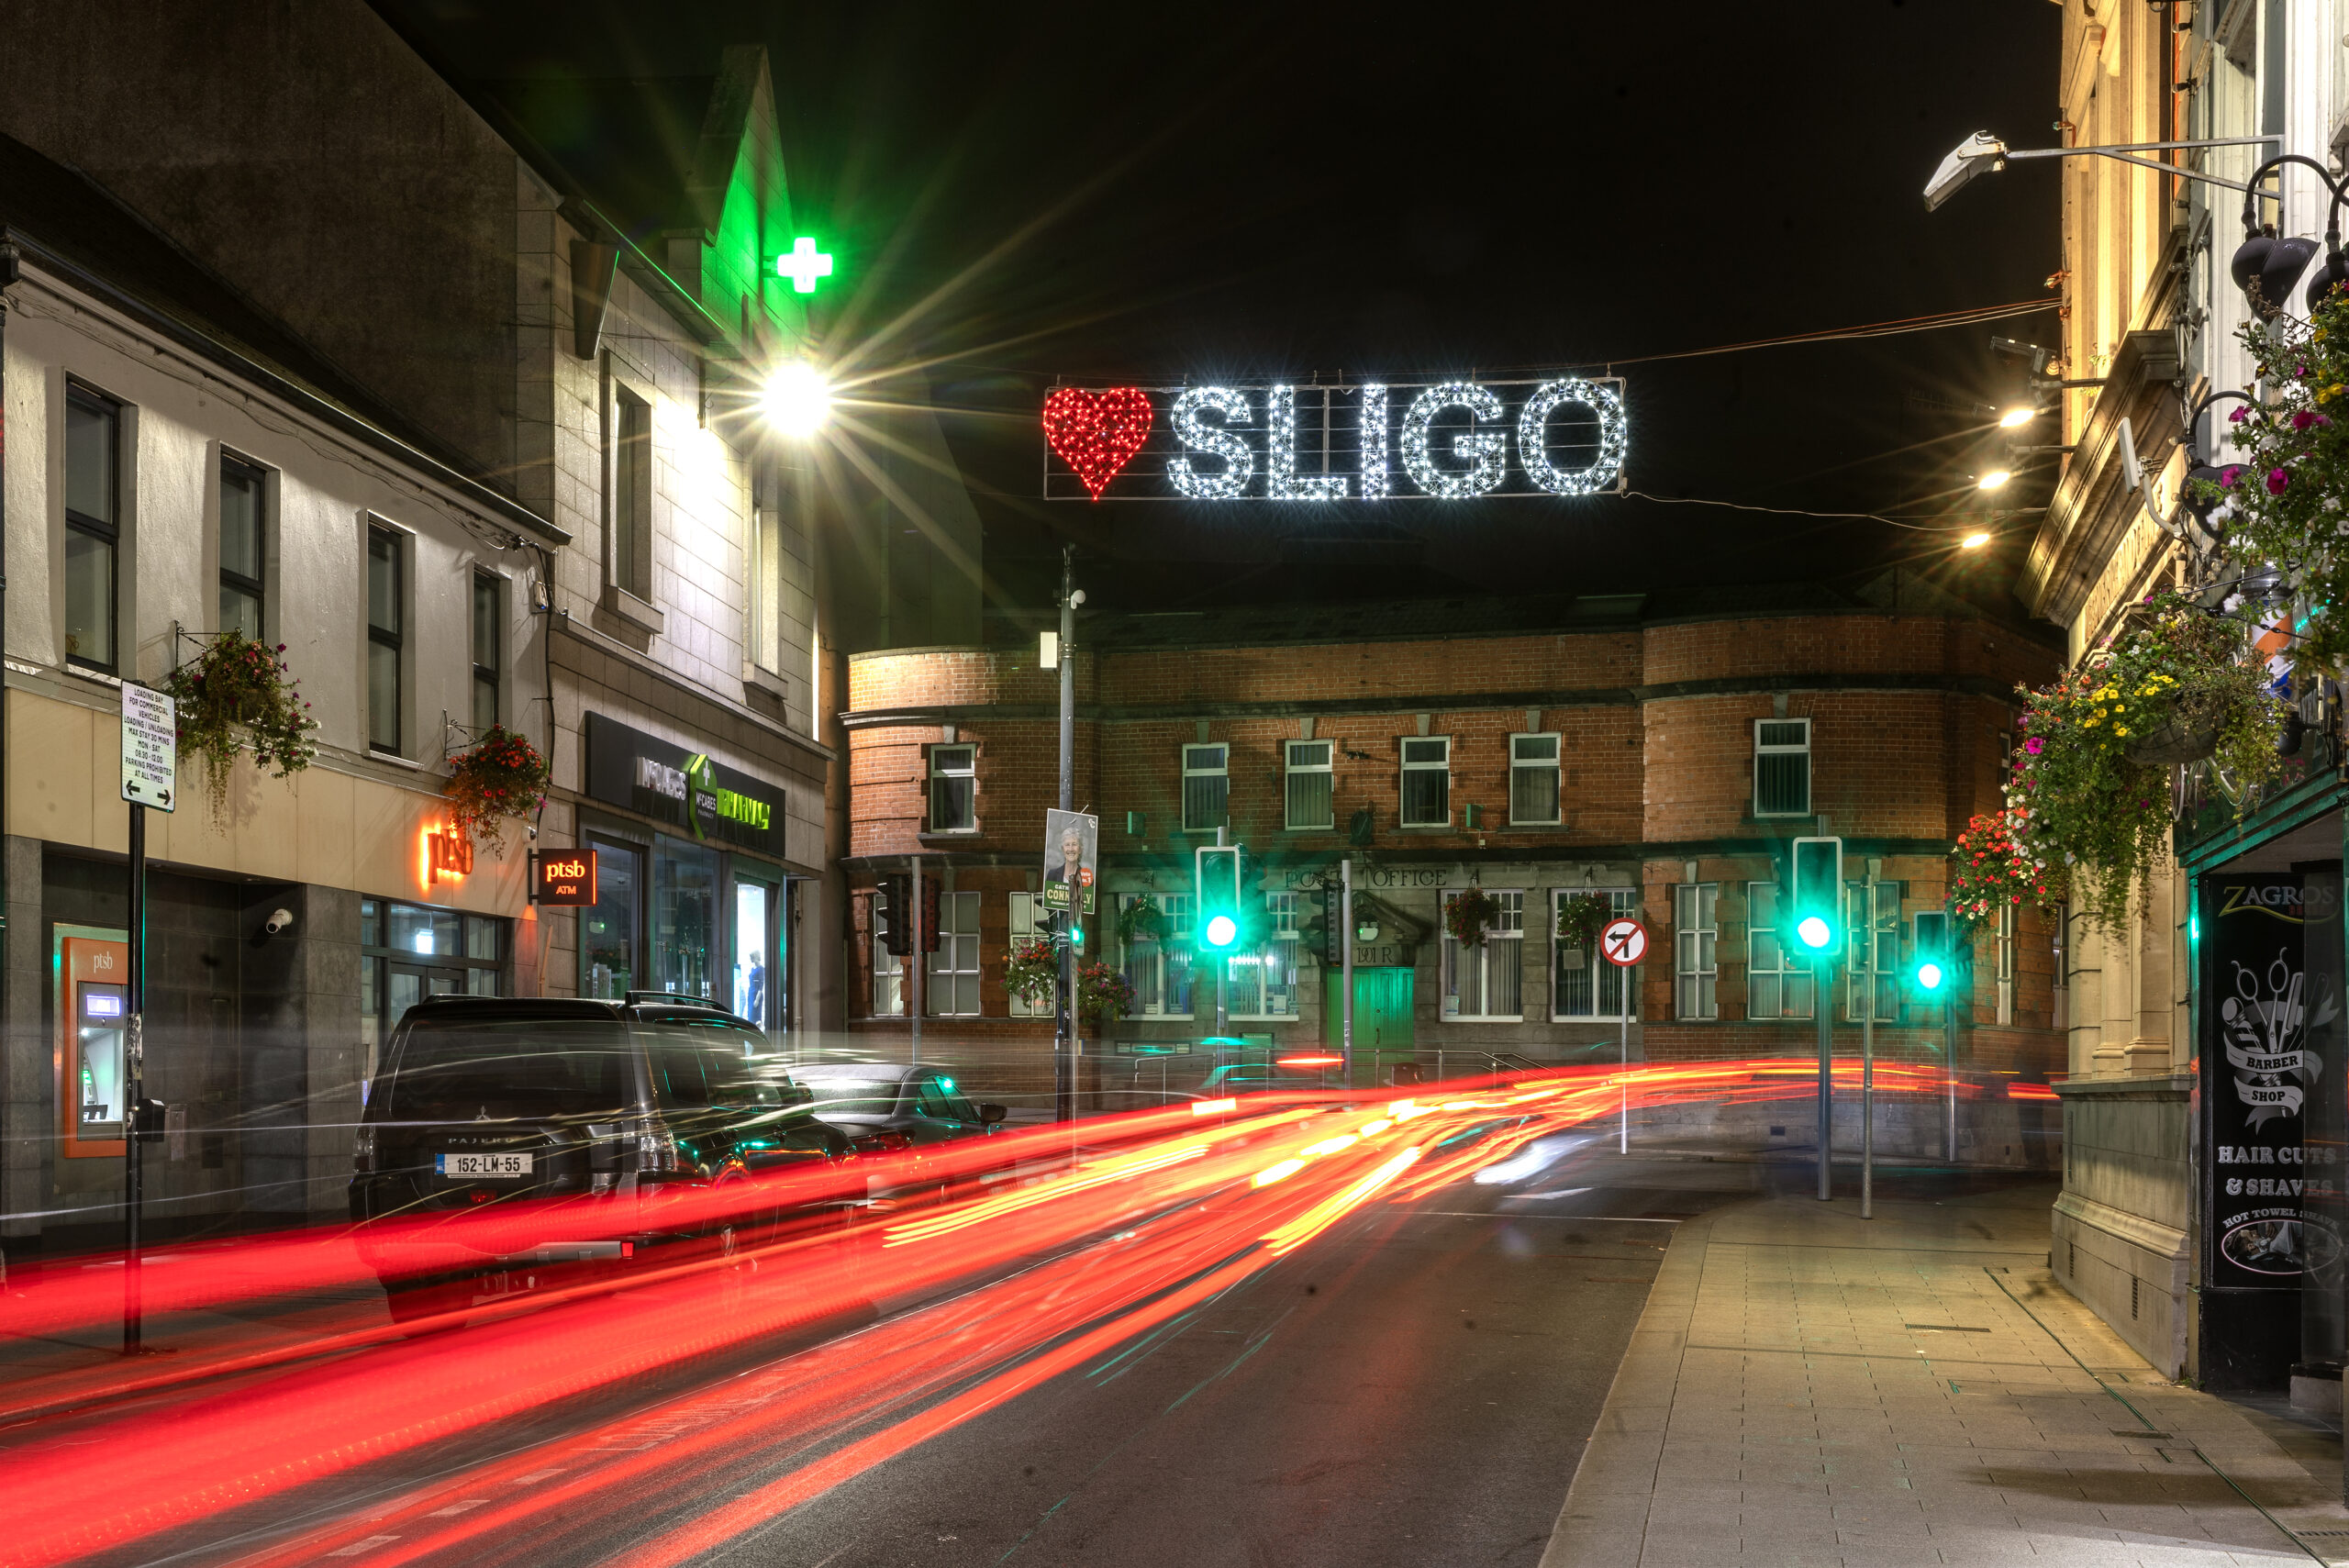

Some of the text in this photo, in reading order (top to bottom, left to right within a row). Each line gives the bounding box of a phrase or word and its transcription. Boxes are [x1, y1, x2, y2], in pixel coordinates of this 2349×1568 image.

[1167, 377, 1627, 500] SLIGO
[134, 688, 163, 704] LOADING BAY
[129, 696, 168, 716] FOR COMMERCIAL
[139, 710, 161, 723] VEHICLES
[124, 716, 144, 728] LOADING
[148, 722, 174, 737] UNLOADING
[128, 727, 170, 746] MAX STAY 30 MINS
[138, 740, 149, 750] MON
[151, 744, 161, 752] SAT
[126, 756, 172, 776] PARKING PROHIBITED
[135, 770, 163, 784] AT ALL TIMES
[428, 828, 473, 884] ptsb
[546, 860, 585, 883] ptsb
[1373, 870, 1447, 887] OFFICE
[556, 885, 577, 895] ATM
[2218, 885, 2335, 917] ZAGROS
[94, 951, 113, 973] ptsb
[2246, 1055, 2299, 1070] BARBER
[2252, 1090, 2286, 1101] SHOP
[2218, 1145, 2336, 1165] HAIR CUTS
[457, 1157, 520, 1173] 152-LM-55
[2225, 1177, 2333, 1196] & SHAVES
[2222, 1211, 2249, 1229] HOT
[2252, 1207, 2297, 1218] TOWEL
